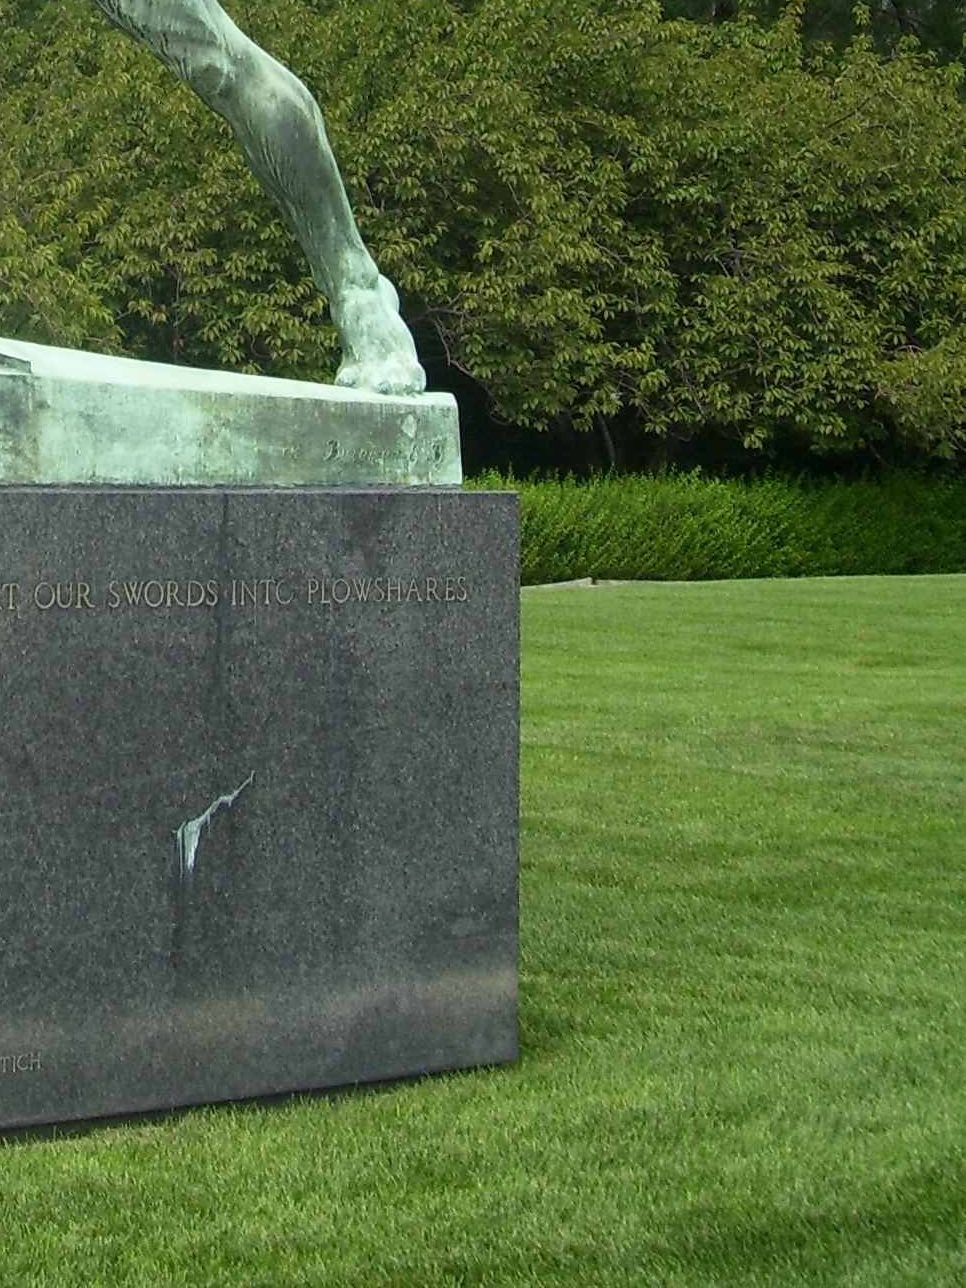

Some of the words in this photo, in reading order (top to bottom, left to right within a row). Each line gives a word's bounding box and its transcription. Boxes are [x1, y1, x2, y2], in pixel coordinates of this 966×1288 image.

[33, 580, 96, 609] OUR
[108, 579, 220, 608] SWORDS
[306, 576, 468, 605] PLOWSHARES
